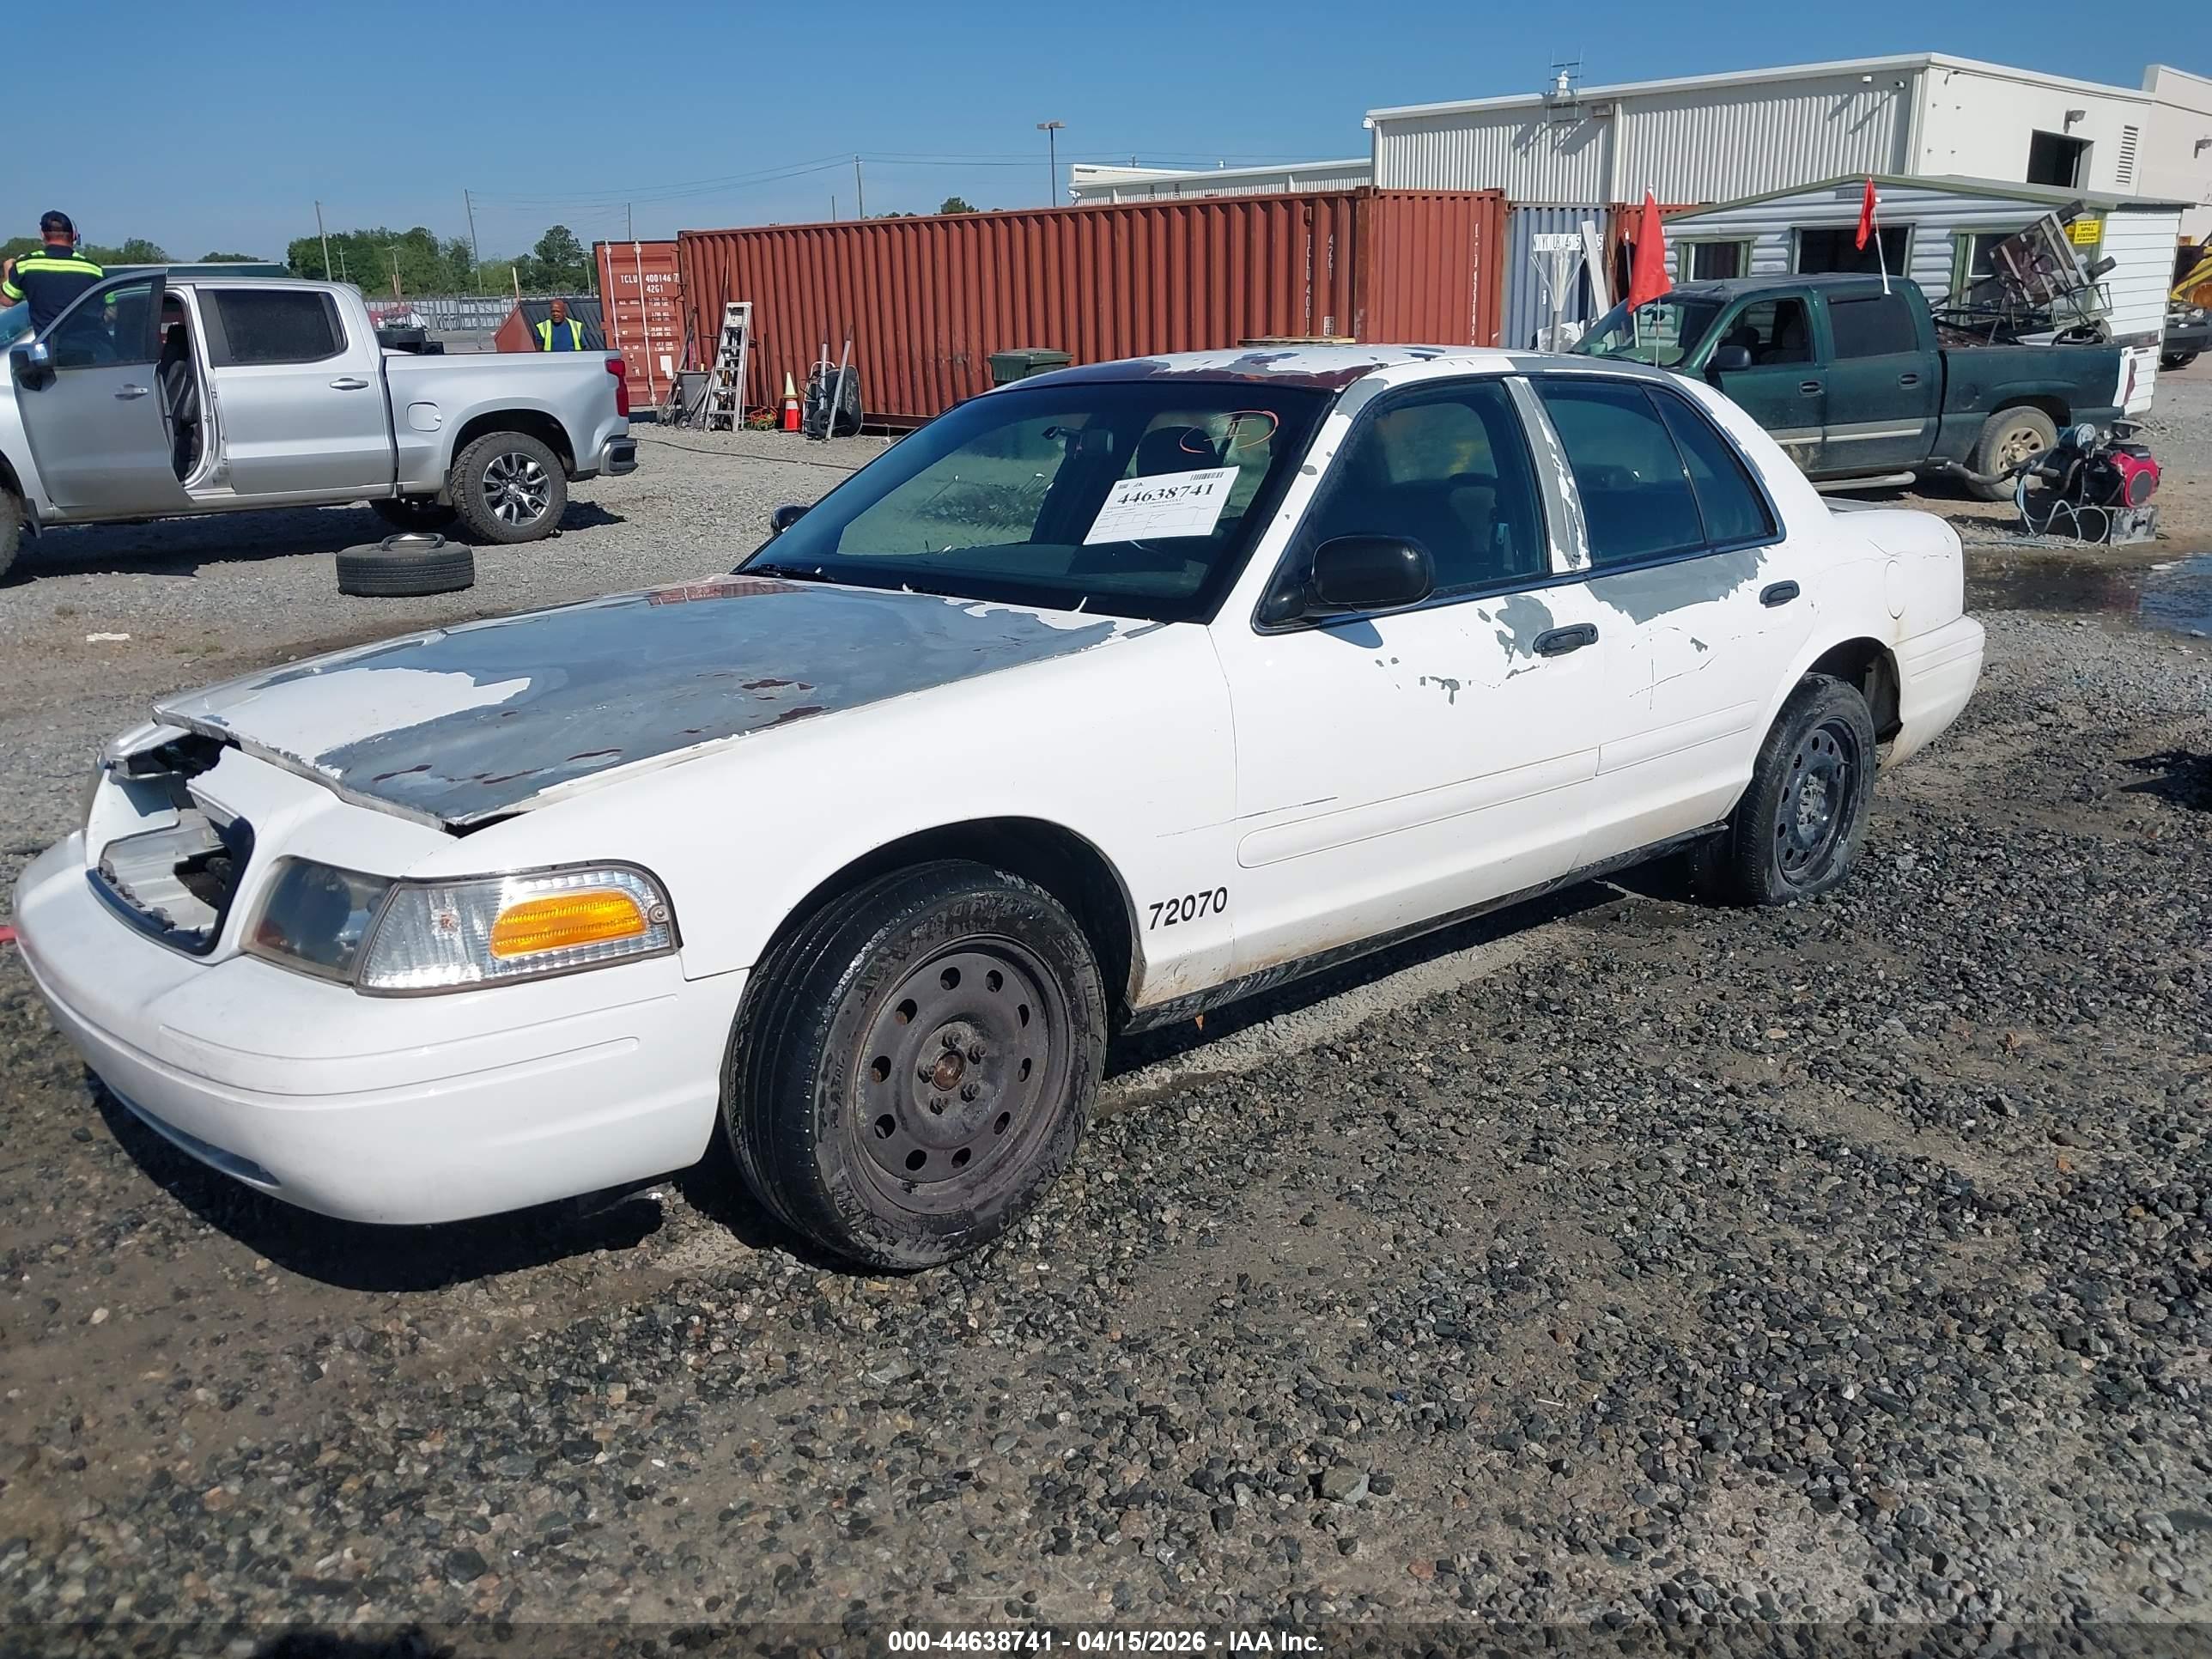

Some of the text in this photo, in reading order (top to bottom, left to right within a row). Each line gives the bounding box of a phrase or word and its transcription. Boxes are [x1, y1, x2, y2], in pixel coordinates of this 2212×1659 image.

[620, 275, 638, 283] TCLU
[646, 274, 672, 283] 400146
[1117, 483, 1214, 504] 44638741
[1149, 886, 1227, 930] 72070
